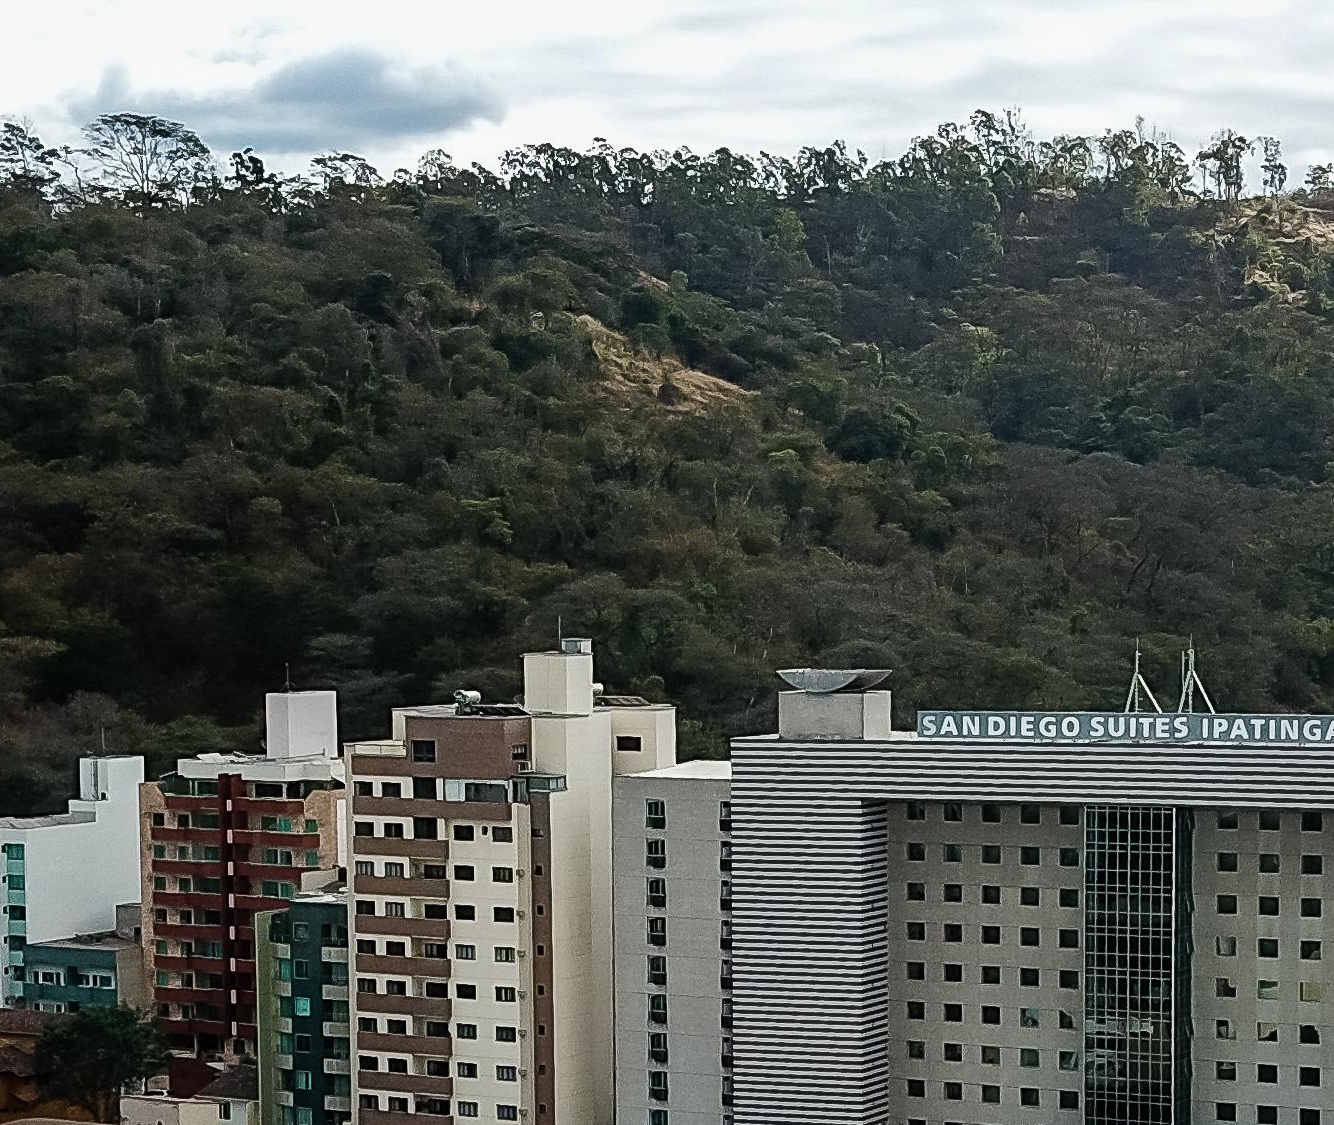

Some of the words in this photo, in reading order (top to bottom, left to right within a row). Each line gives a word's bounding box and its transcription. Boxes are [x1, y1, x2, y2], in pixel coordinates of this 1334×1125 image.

[922, 715, 980, 736] SAN
[987, 716, 1080, 738] DIEGO
[1089, 716, 1189, 739] SUITES
